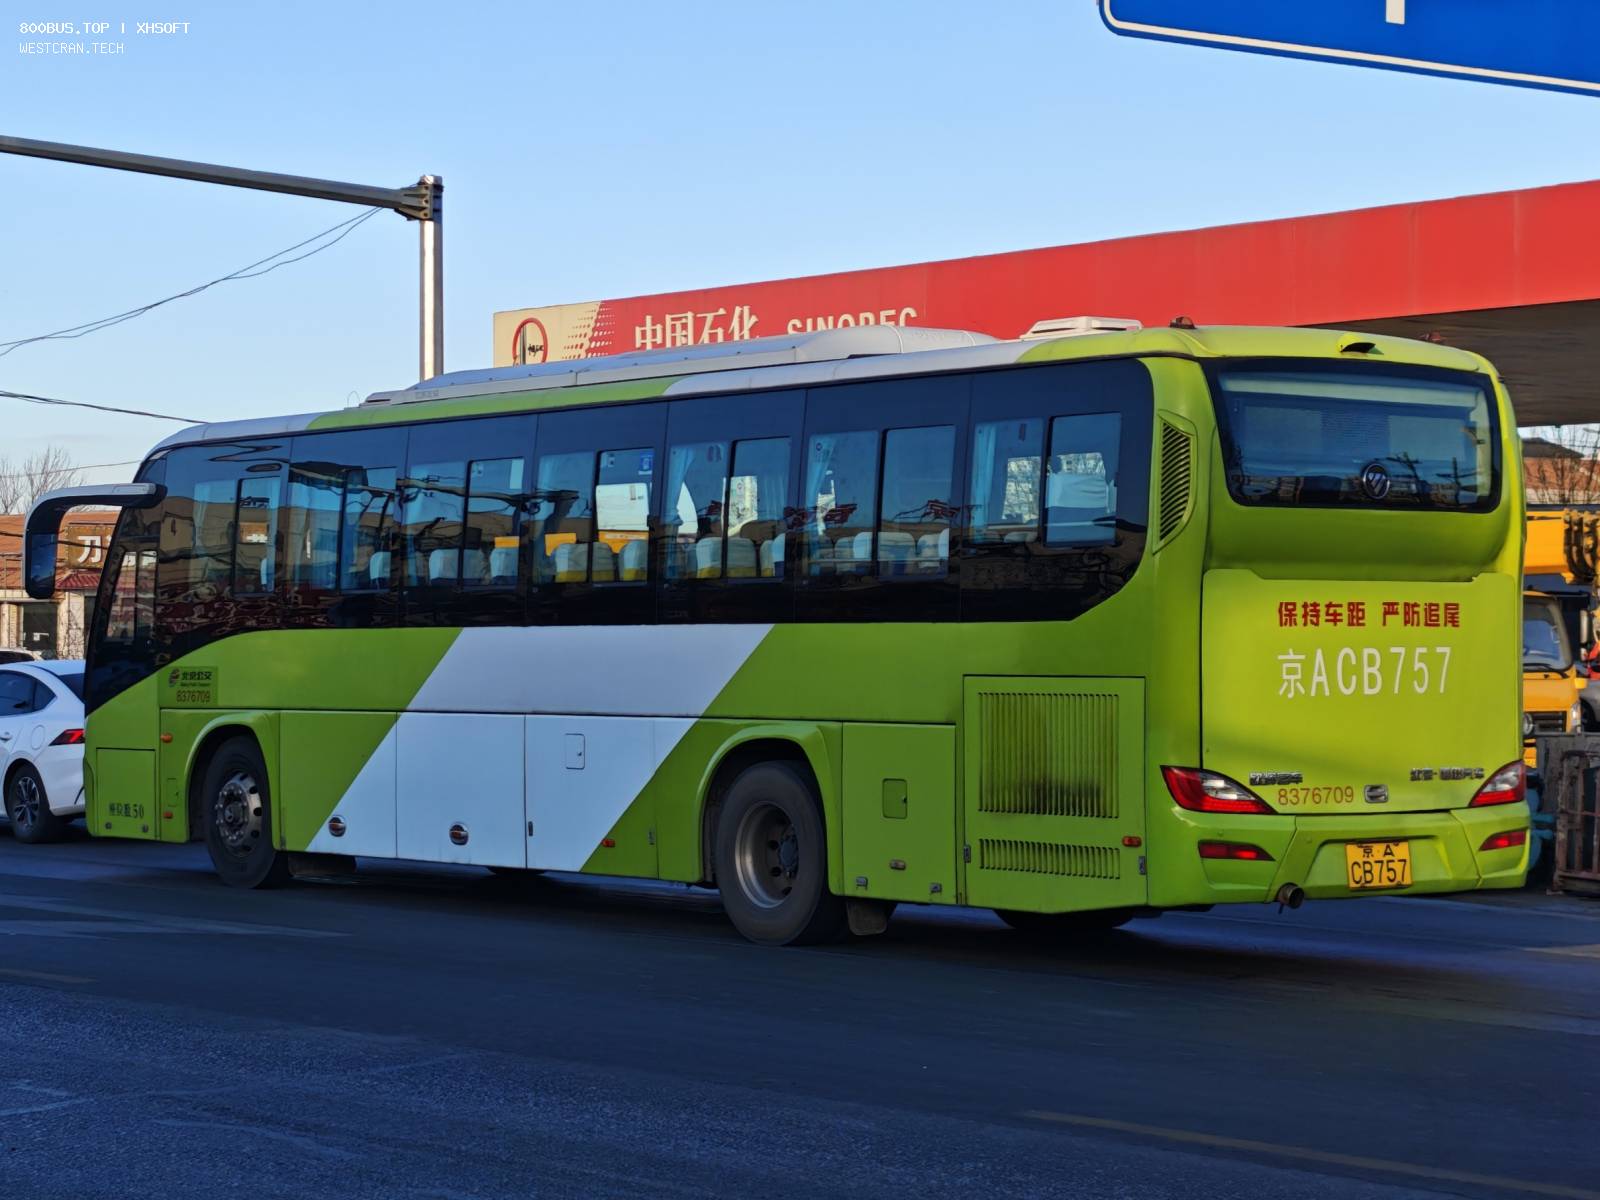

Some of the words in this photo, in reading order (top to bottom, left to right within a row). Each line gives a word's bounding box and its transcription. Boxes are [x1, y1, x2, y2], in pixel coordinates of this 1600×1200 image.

[635, 305, 759, 350] 中国石化
[77, 534, 112, 563] 刀
[1278, 602, 1366, 627] 保持车距
[1382, 602, 1460, 627] 严防追尾
[1277, 646, 1451, 699] 京ACB757
[176, 690, 211, 703] 8376709
[1278, 786, 1354, 805] 8376709
[1383, 844, 1395, 857] A
[1351, 859, 1408, 884] CB757
